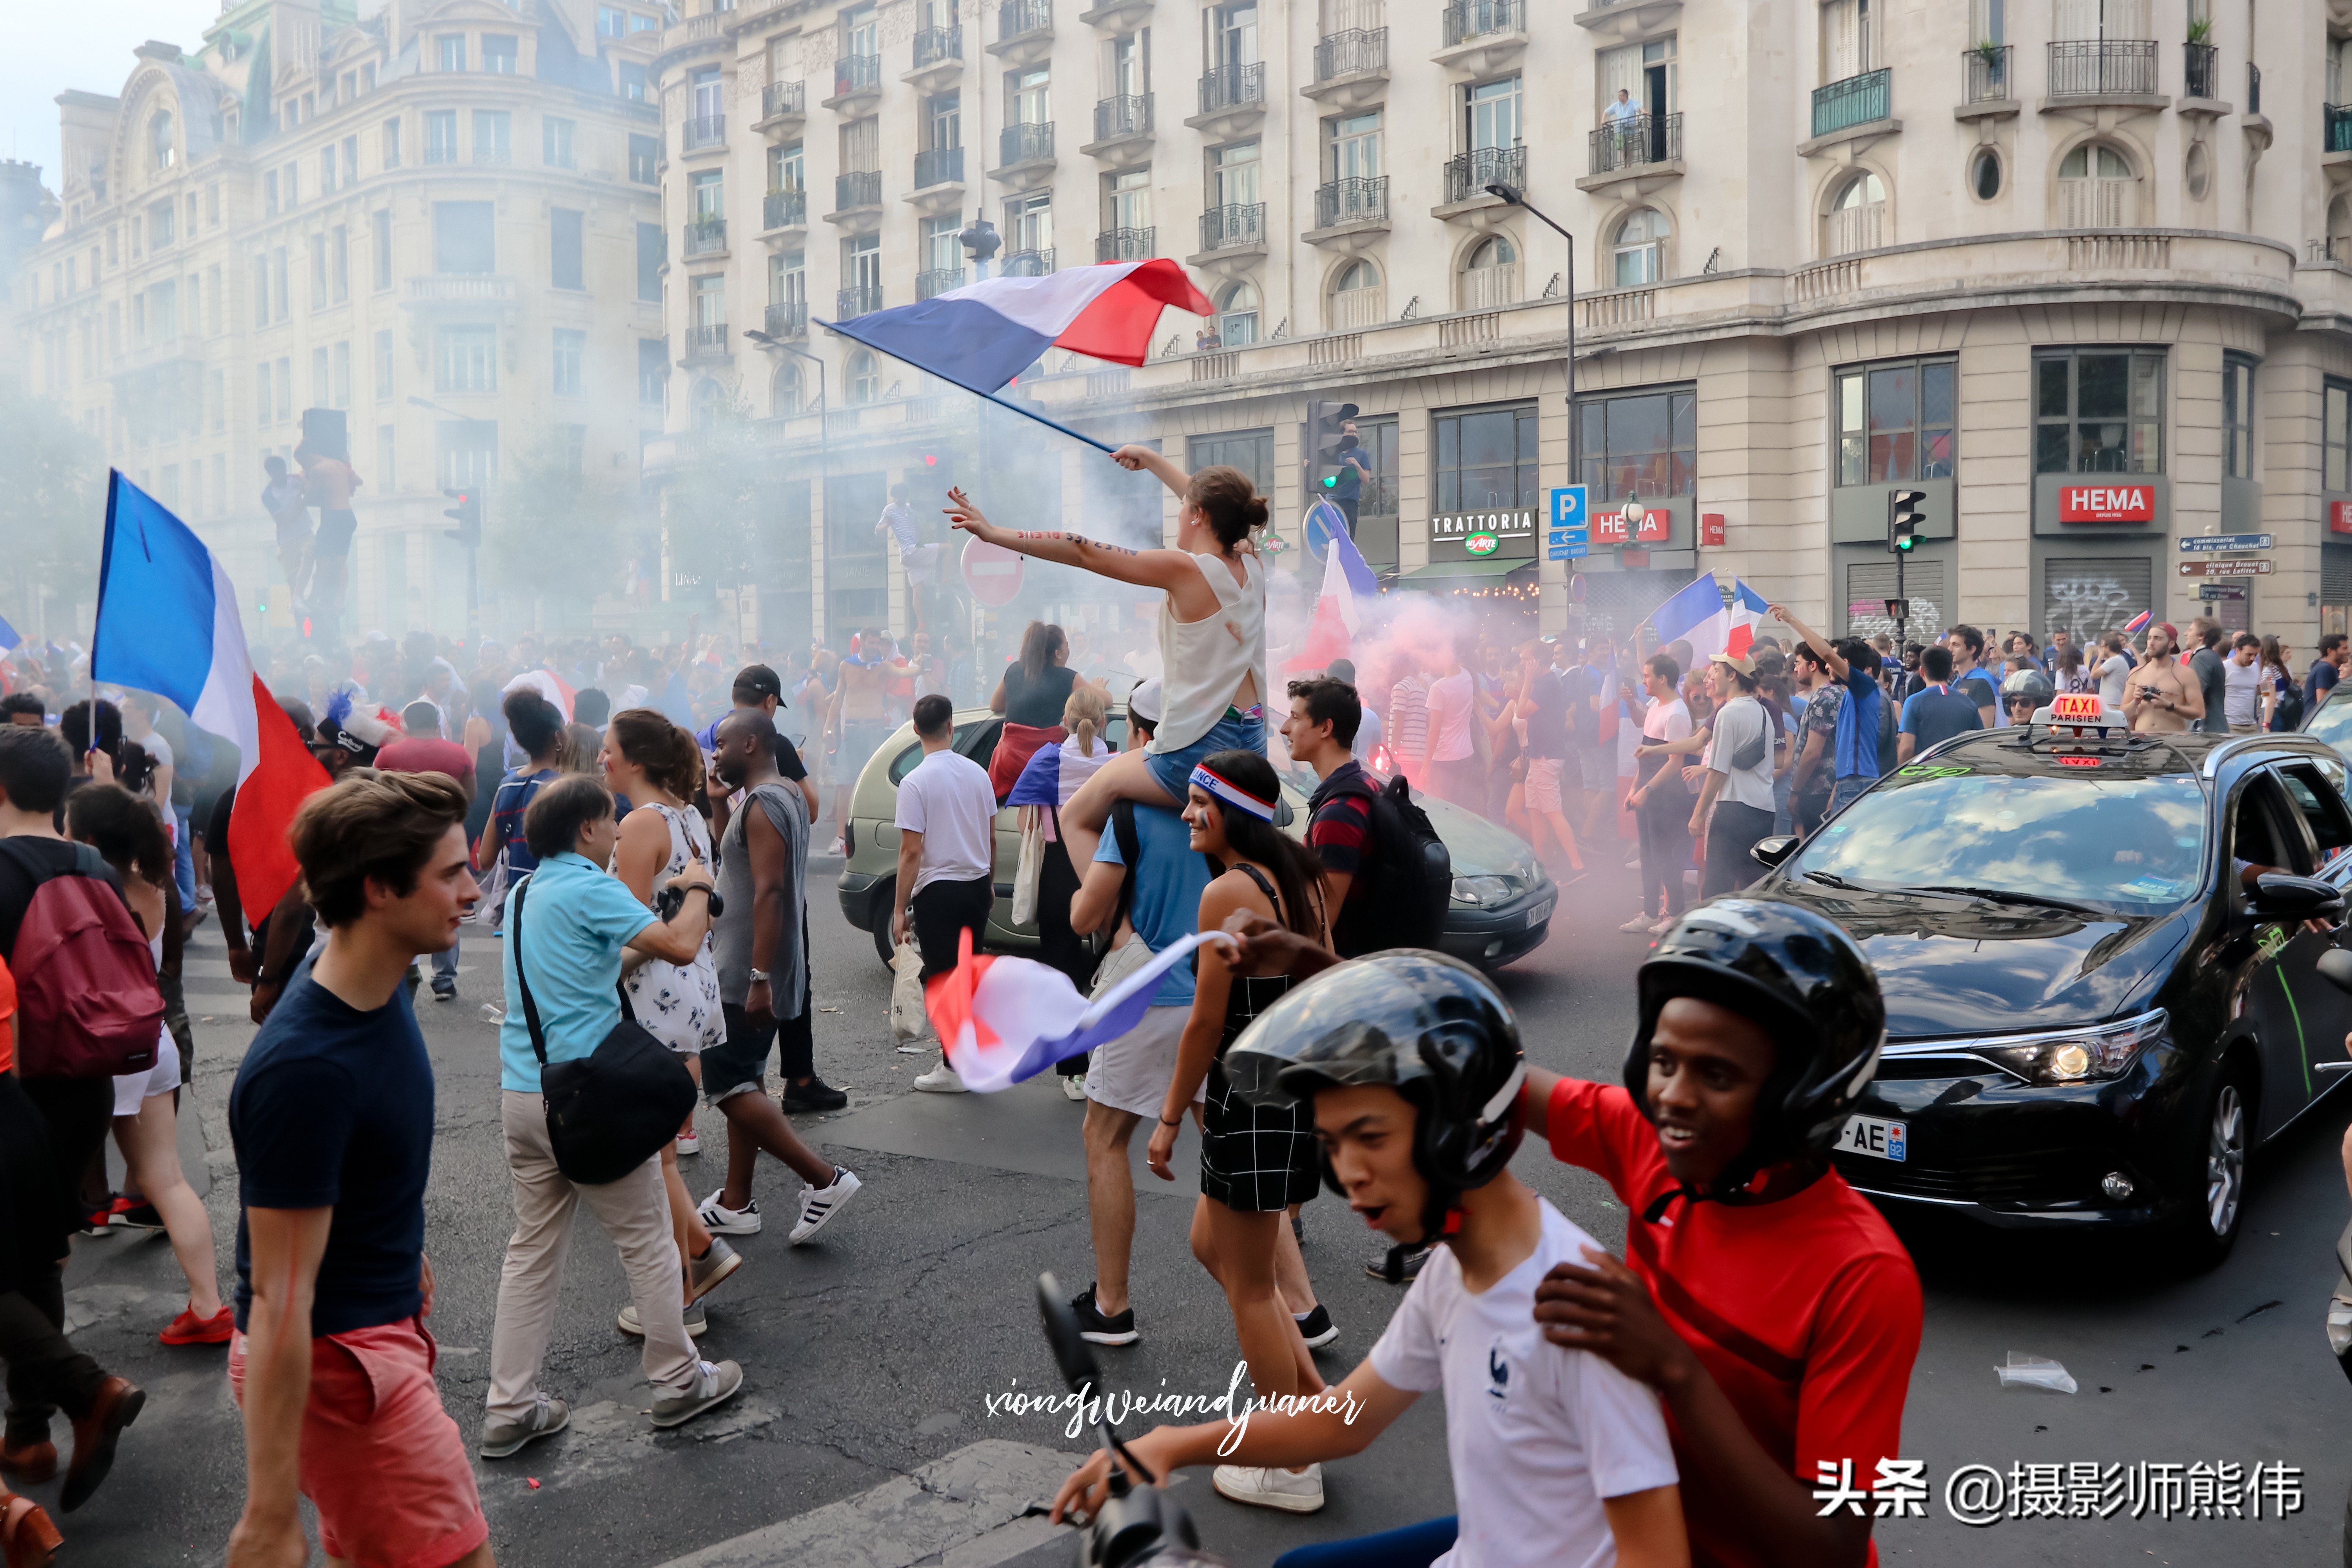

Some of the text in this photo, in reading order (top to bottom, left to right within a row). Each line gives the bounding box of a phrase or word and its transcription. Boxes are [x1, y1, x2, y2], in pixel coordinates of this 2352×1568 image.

[2071, 488, 2145, 511] HEMA
[1560, 494, 1576, 521] P
[1433, 512, 1531, 534] TRATTORIA
[1600, 513, 1657, 534] HEA
[1710, 525, 1723, 535] HEMA
[1468, 537, 1496, 551] ARTE
[2060, 698, 2094, 713] TAXI
[2051, 714, 2101, 722] PARISIEN
[1898, 766, 1945, 776] G7
[1890, 1144, 1902, 1156] 92
